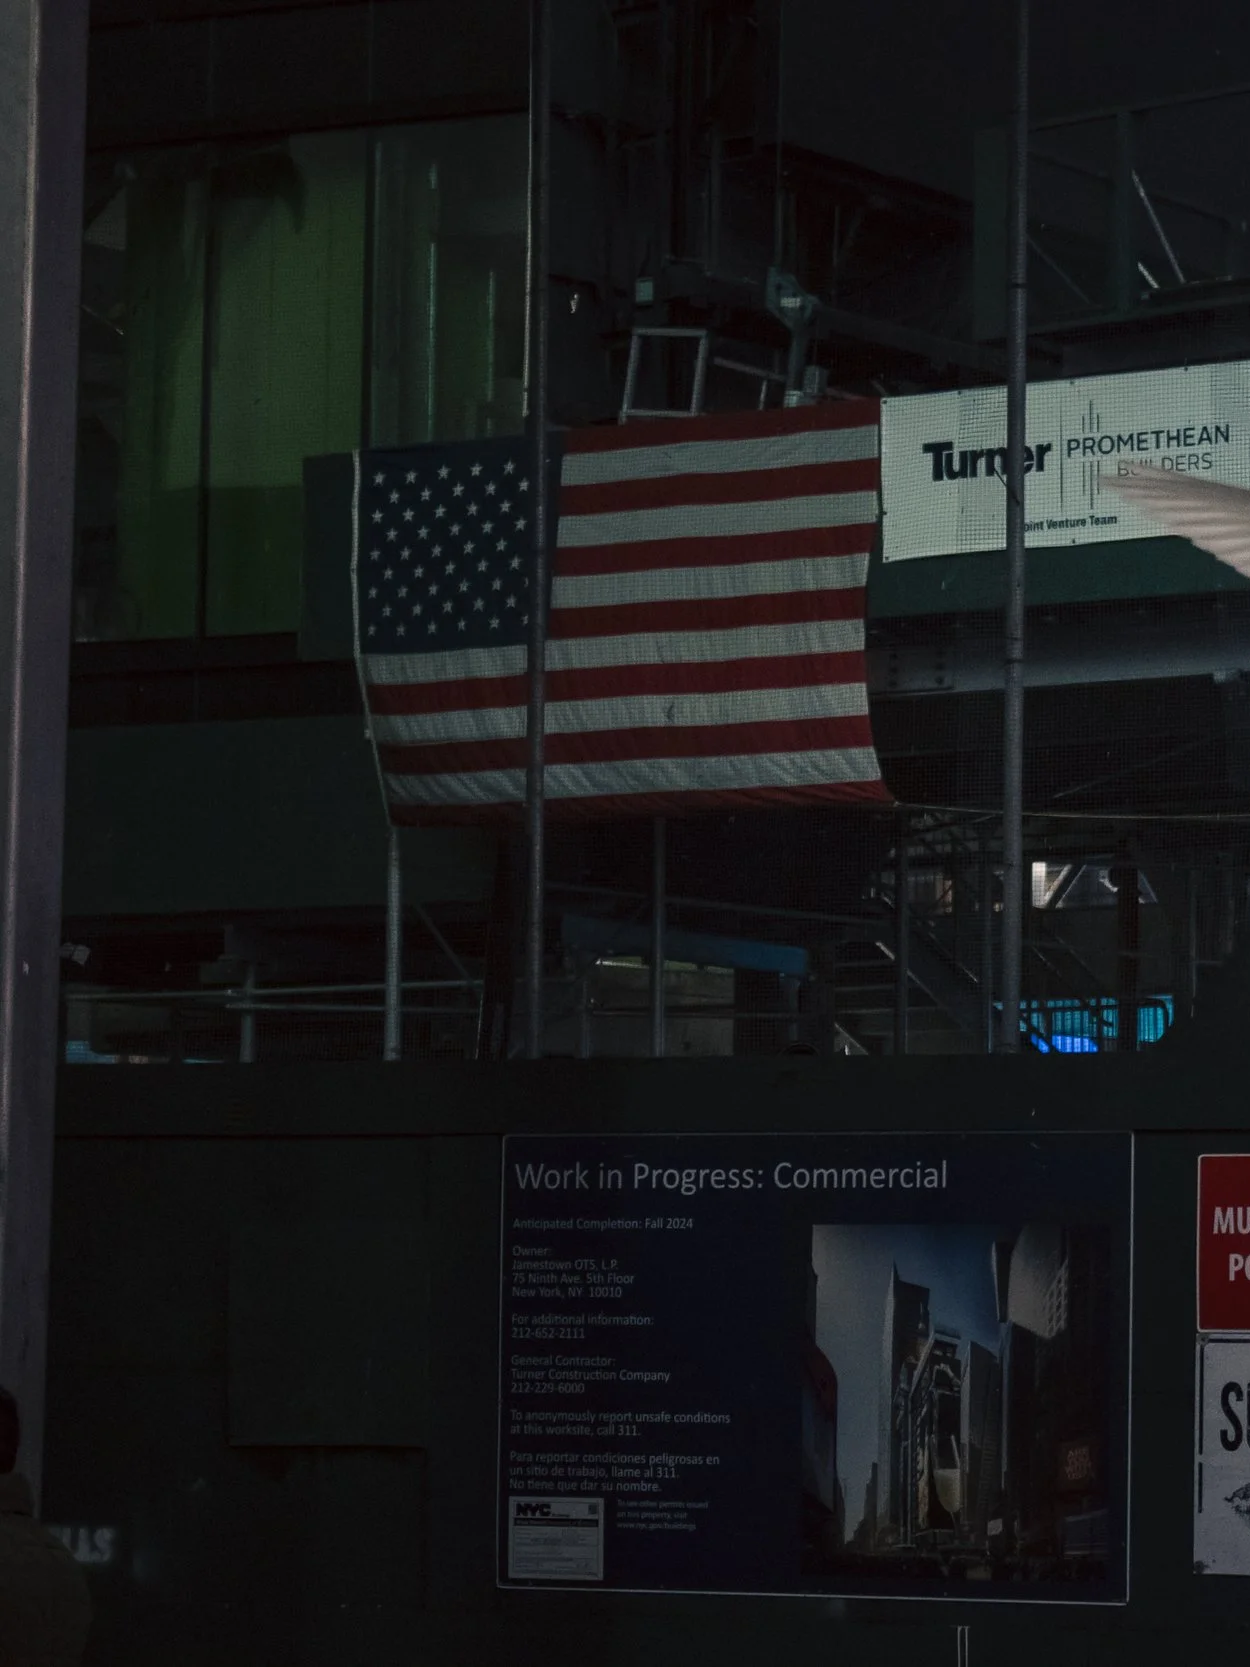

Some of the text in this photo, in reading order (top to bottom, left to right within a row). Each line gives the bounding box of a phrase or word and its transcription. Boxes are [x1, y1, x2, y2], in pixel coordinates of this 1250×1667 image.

[1066, 424, 1230, 458] PROMETHEAN
[1117, 453, 1213, 477] BDERS
[1023, 515, 1118, 532] oint Venture Team
[515, 1160, 947, 1196] Work in Progress: Commercial
[512, 1218, 694, 1231] Anticipated Completion: Fall 2024
[512, 1245, 552, 1257] Owner:
[511, 1259, 571, 1271] Jamestown
[512, 1273, 526, 1284] 75
[528, 1273, 557, 1284] Ninth
[586, 1273, 605, 1284] 5th
[607, 1273, 634, 1284] Floor
[512, 1287, 537, 1298] New
[539, 1287, 564, 1299] York,
[568, 1287, 583, 1298] NY
[511, 1313, 654, 1325] For additional information:
[511, 1355, 616, 1367] General Contractor:
[511, 1369, 670, 1383] Turner Construction Company
[511, 1383, 585, 1394] 212-229-6000
[510, 1410, 731, 1424] To anonymously report unsafe conditions
[510, 1424, 641, 1437] at this worksite, call 311.
[510, 1451, 720, 1466] Para reportar condiciones peligrosas en
[509, 1467, 524, 1476] un
[526, 1466, 547, 1476] sitio
[551, 1466, 564, 1476] de
[567, 1466, 608, 1479] trabajo,
[611, 1466, 641, 1478] llame
[644, 1466, 653, 1478] al
[509, 1479, 662, 1493] No tiene que dar su nombre.
[516, 1503, 551, 1517] NYC
